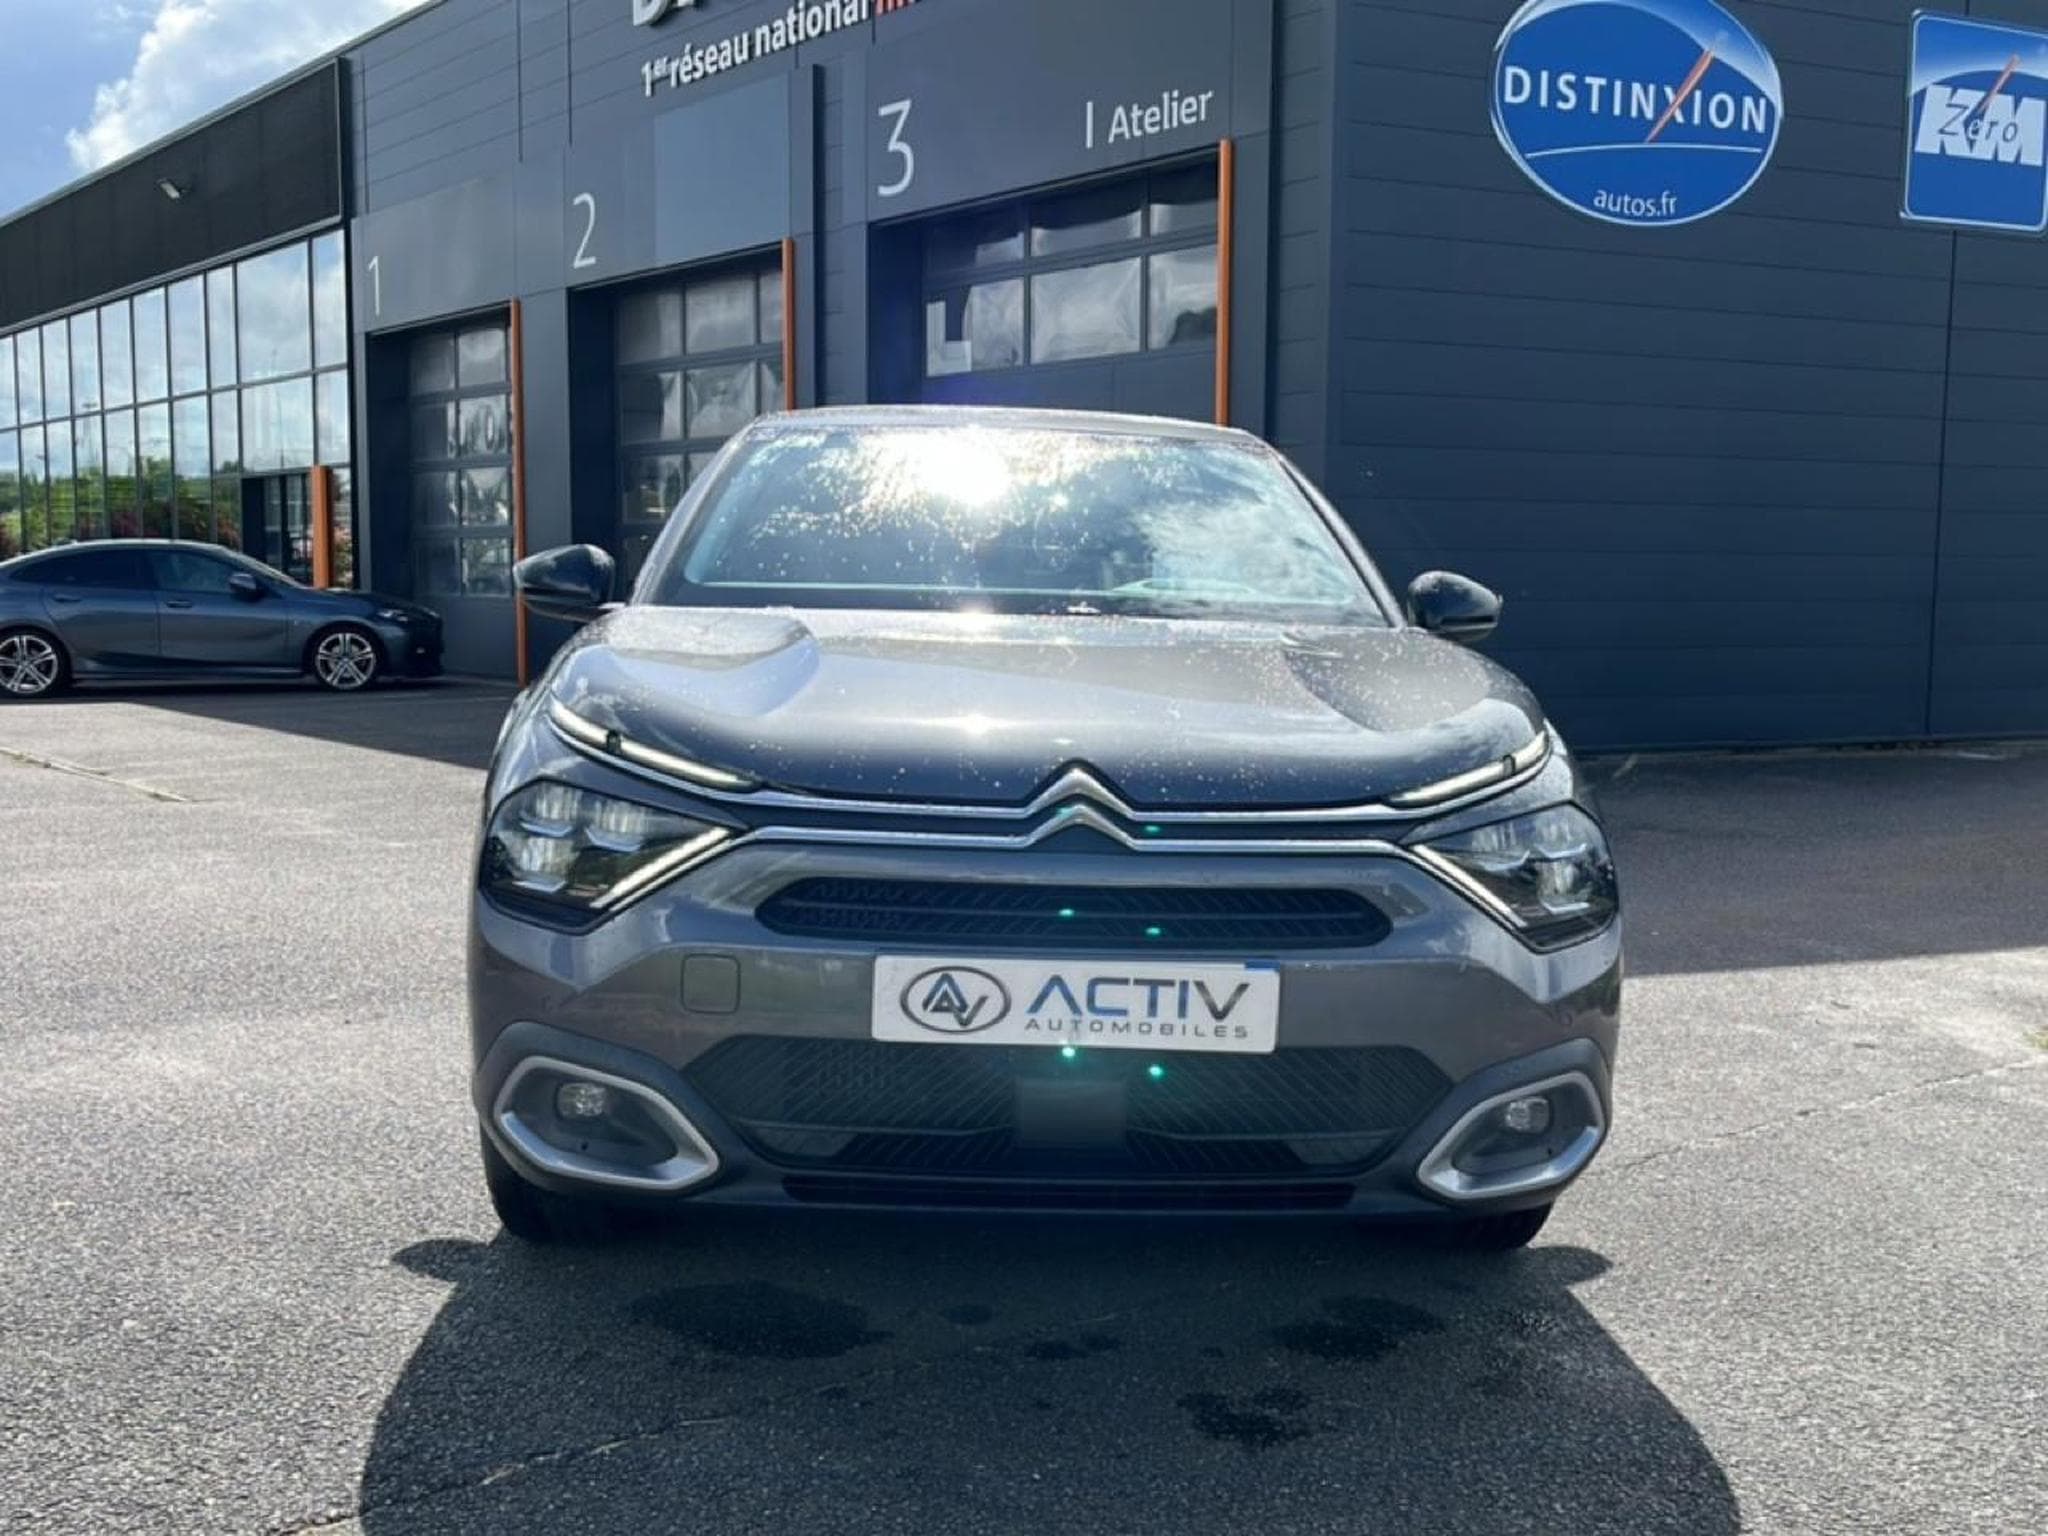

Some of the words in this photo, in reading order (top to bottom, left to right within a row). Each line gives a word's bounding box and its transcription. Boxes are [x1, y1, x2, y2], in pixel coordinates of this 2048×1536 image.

[670, 32, 749, 88] réseau
[755, 0, 869, 57] national
[1108, 89, 1215, 144] Atelier
[1504, 65, 1767, 134] DISTINXION
[1938, 103, 2019, 143] Zero
[877, 99, 914, 197] 3
[572, 192, 597, 269] 2
[1593, 188, 1678, 217] autos.fr
[367, 255, 382, 317] 1
[1025, 974, 1251, 1021] ACTIV
[1023, 1018, 1250, 1039] AUTOMOBILES
